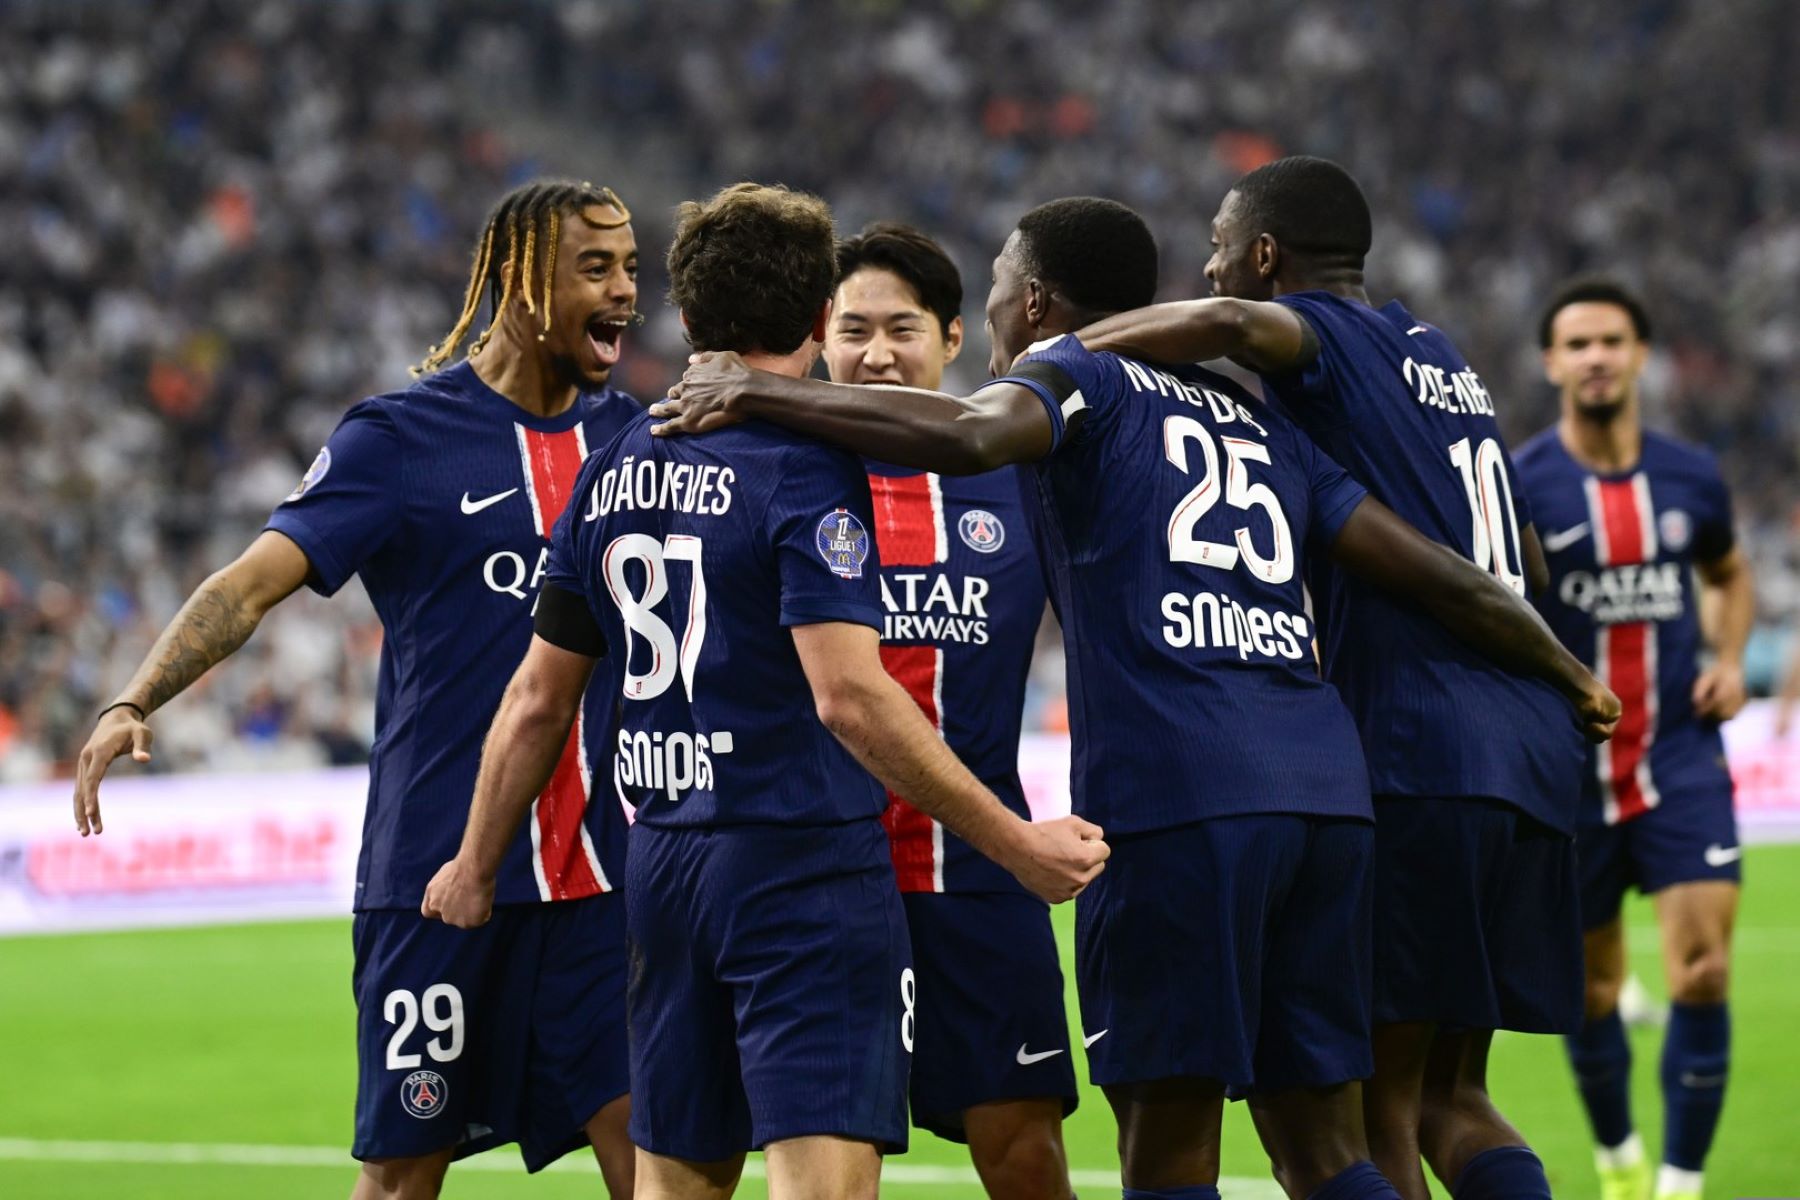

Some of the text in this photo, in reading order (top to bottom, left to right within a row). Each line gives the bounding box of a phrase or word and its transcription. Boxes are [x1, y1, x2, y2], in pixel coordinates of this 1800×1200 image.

[584, 455, 657, 522] JOÃO
[1164, 415, 1294, 584] 25
[1448, 437, 1526, 599] 10
[602, 533, 706, 703] 87
[880, 615, 989, 645] IRWAYS
[1161, 591, 1304, 661] snipes
[384, 983, 465, 1070] 29
[901, 968, 915, 1053] 8
[407, 1072, 440, 1085] PARIS
